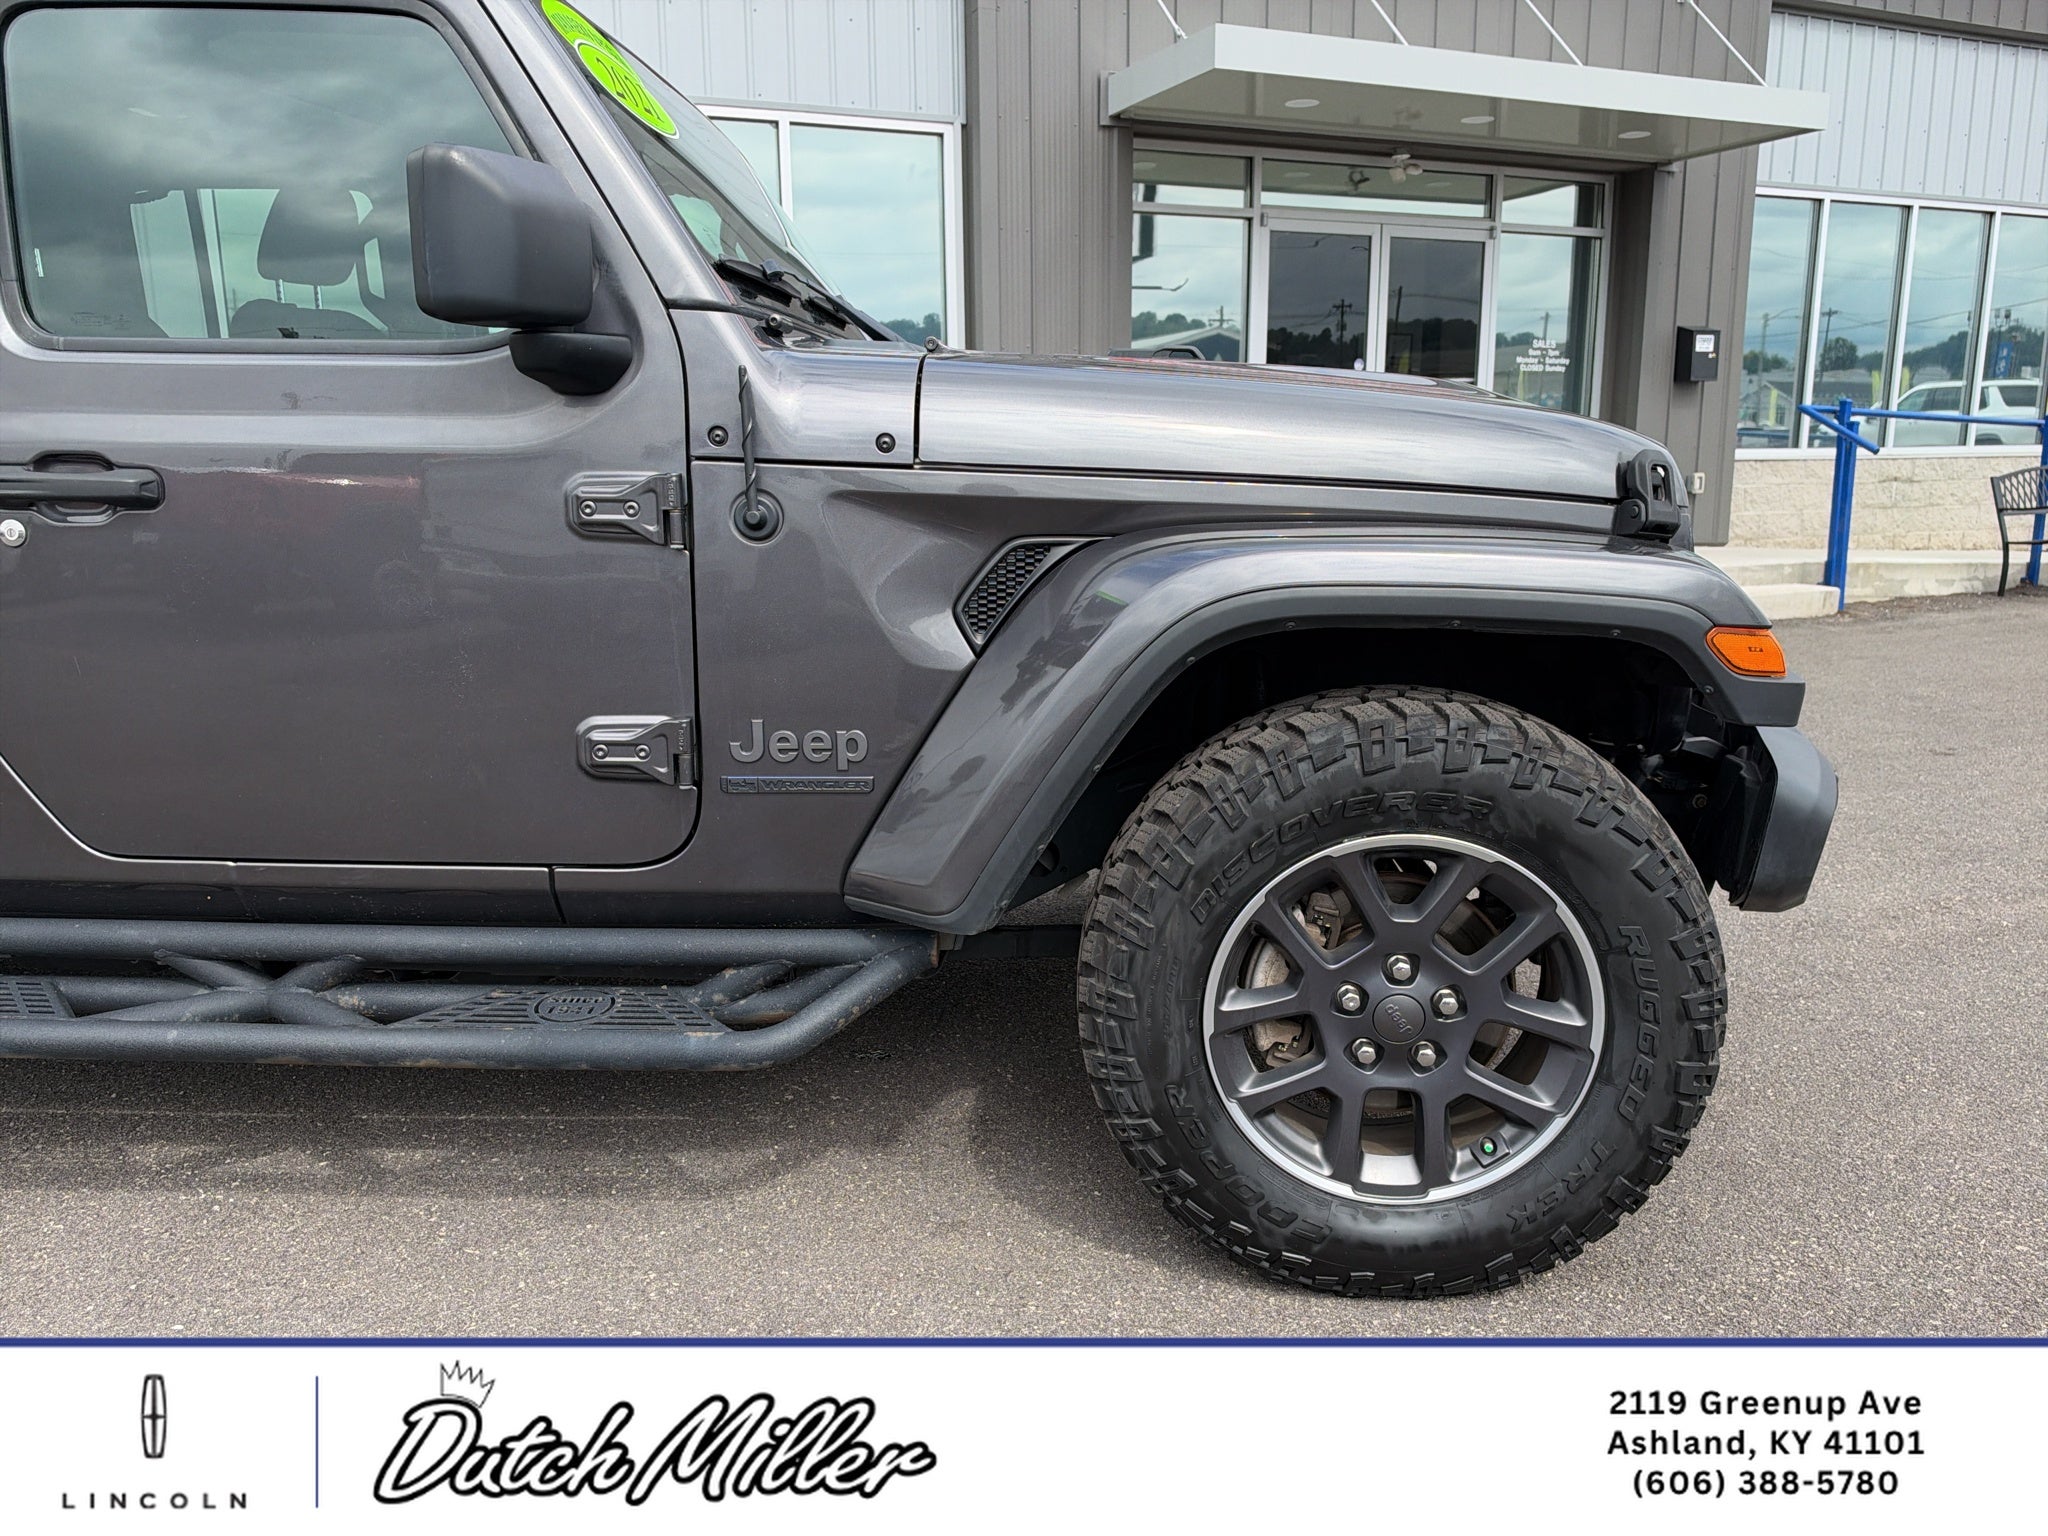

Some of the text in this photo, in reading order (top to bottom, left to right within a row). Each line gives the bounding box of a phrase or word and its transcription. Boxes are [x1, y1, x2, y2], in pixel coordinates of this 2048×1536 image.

[594, 56, 665, 123] 2021
[1516, 355, 1539, 364] Monday
[1545, 356, 1571, 366] Saturday
[1519, 363, 1567, 373] CLOSED Sunday
[1532, 339, 1557, 349] SALES
[728, 718, 868, 771] Jeep
[1190, 789, 1494, 925] DISCOVERER
[547, 1005, 596, 1014] 1941
[1385, 1003, 1414, 1034] Jeep
[1616, 925, 1663, 1121] RUGGED
[1164, 1084, 1332, 1244] COOPER
[1506, 1140, 1617, 1234] TREK
